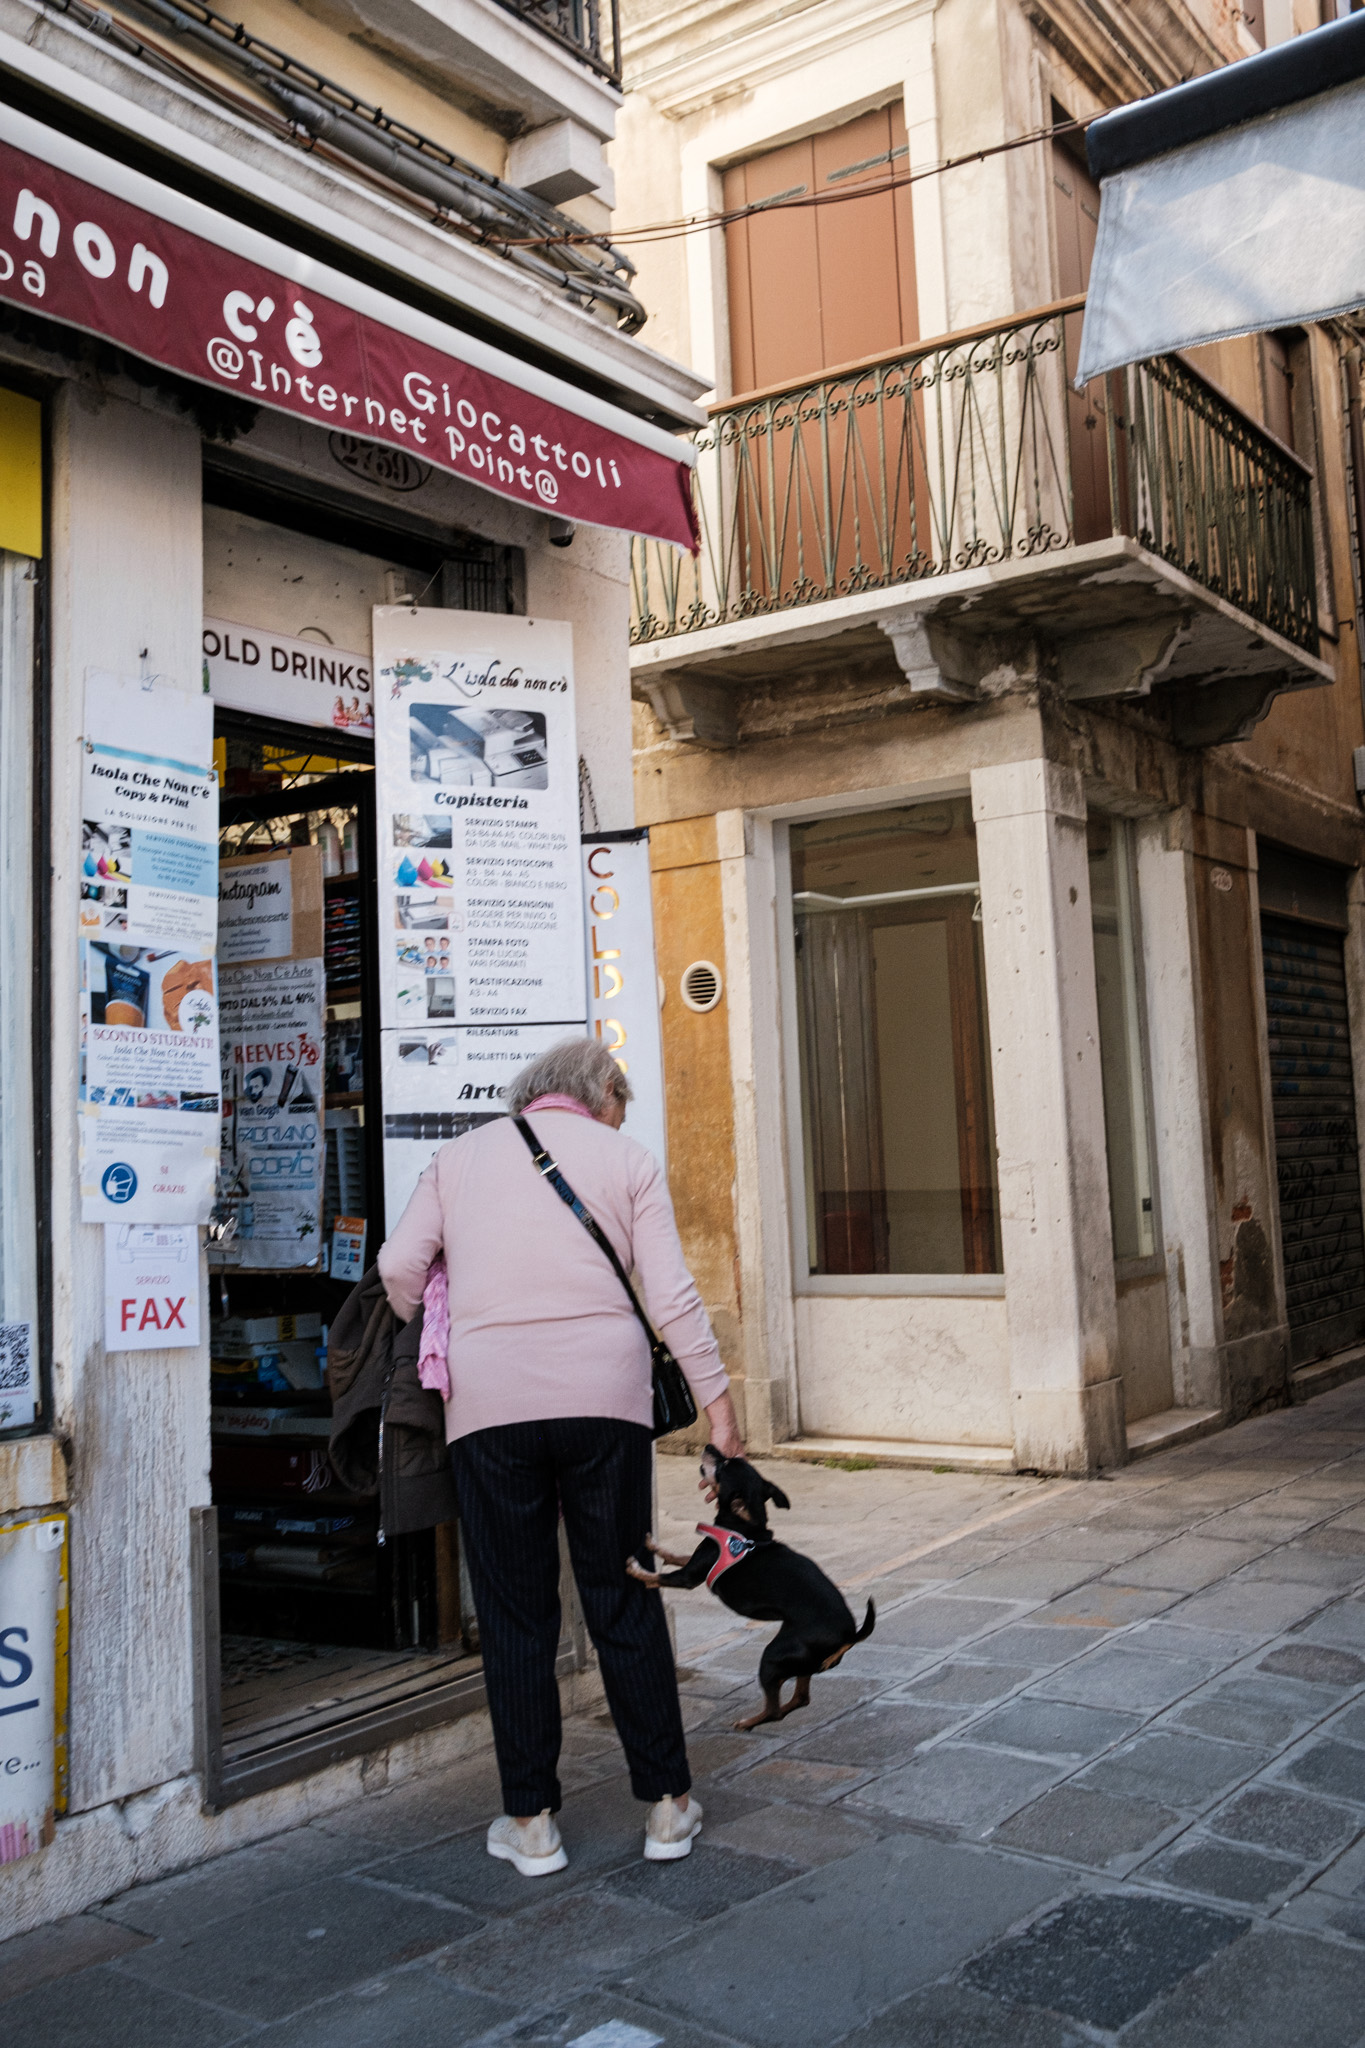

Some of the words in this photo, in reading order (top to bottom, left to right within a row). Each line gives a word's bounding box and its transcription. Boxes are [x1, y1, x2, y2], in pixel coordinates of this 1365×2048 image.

[13, 188, 169, 309] non
[223, 289, 323, 368] c'è
[206, 336, 427, 444] @Internet
[402, 370, 622, 489] Giocattoli
[271, 646, 370, 693] DRINKS
[499, 667, 523, 688] che
[523, 677, 547, 690] non
[549, 676, 568, 693] c'è
[90, 763, 129, 782] Isola
[132, 771, 161, 787] Che
[163, 777, 189, 794] Non
[190, 785, 211, 800] C'è
[115, 785, 147, 802] Copy
[148, 792, 159, 803] &
[161, 793, 190, 809] Print
[434, 792, 529, 809] Copisteria
[464, 817, 504, 827] SERVIZIO
[505, 819, 539, 829] STAMPE
[465, 857, 505, 867] SERVIZIO
[506, 858, 554, 869] FOTOCOPIE
[466, 877, 498, 887] COLORI
[504, 879, 537, 888] BIANCO
[544, 880, 568, 890] NERO
[467, 898, 506, 907] SERVIZIO
[507, 899, 554, 909] SCANSIONI
[481, 920, 502, 928] ALTA
[503, 920, 558, 930] RISOLUZIONE
[467, 938, 503, 946] STAMPA
[505, 938, 529, 947] FOTO
[468, 949, 495, 957] CARTA
[489, 959, 527, 968] FORMATI
[469, 977, 544, 987] PLASTIFICAZIONE
[280, 994, 293, 1006] AL
[469, 1006, 509, 1016] SERVIZIO
[510, 1006, 528, 1016] FAX
[93, 1028, 148, 1044] SCONTO
[466, 1028, 520, 1037] RILEGATURE
[234, 1040, 296, 1064] REEVES
[467, 1052, 508, 1061] BIGLIETTI
[509, 1052, 522, 1061] DA
[238, 1124, 318, 1143] FABRIANO
[249, 1151, 315, 1175] COPIC
[135, 1274, 171, 1285] SERVIZIO
[121, 1296, 186, 1332] FAX
